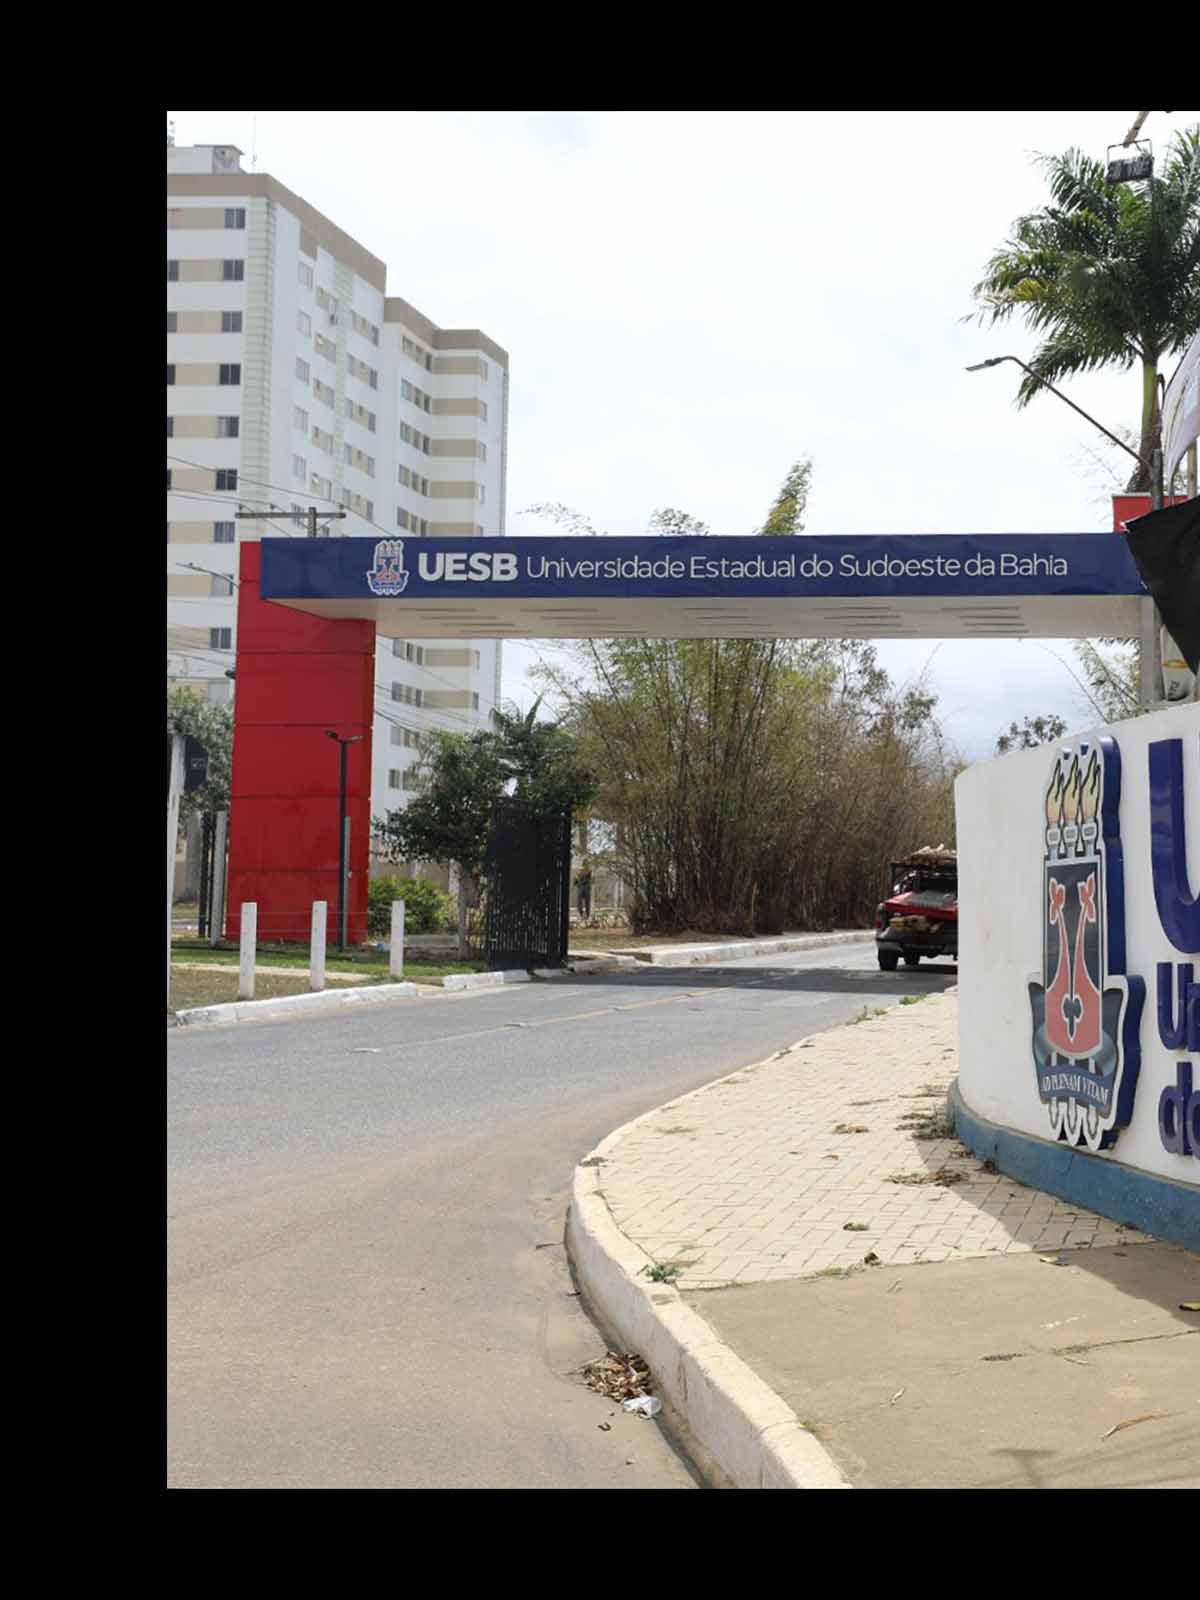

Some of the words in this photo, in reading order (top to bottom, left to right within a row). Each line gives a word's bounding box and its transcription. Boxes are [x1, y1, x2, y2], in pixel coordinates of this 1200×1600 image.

[418, 552, 519, 582] UESB
[526, 554, 685, 579] Universidade
[690, 554, 796, 579] Estadual
[800, 553, 833, 578] do
[839, 553, 960, 578] Sudoeste
[964, 552, 995, 576] da
[1000, 552, 1068, 577] Bahia
